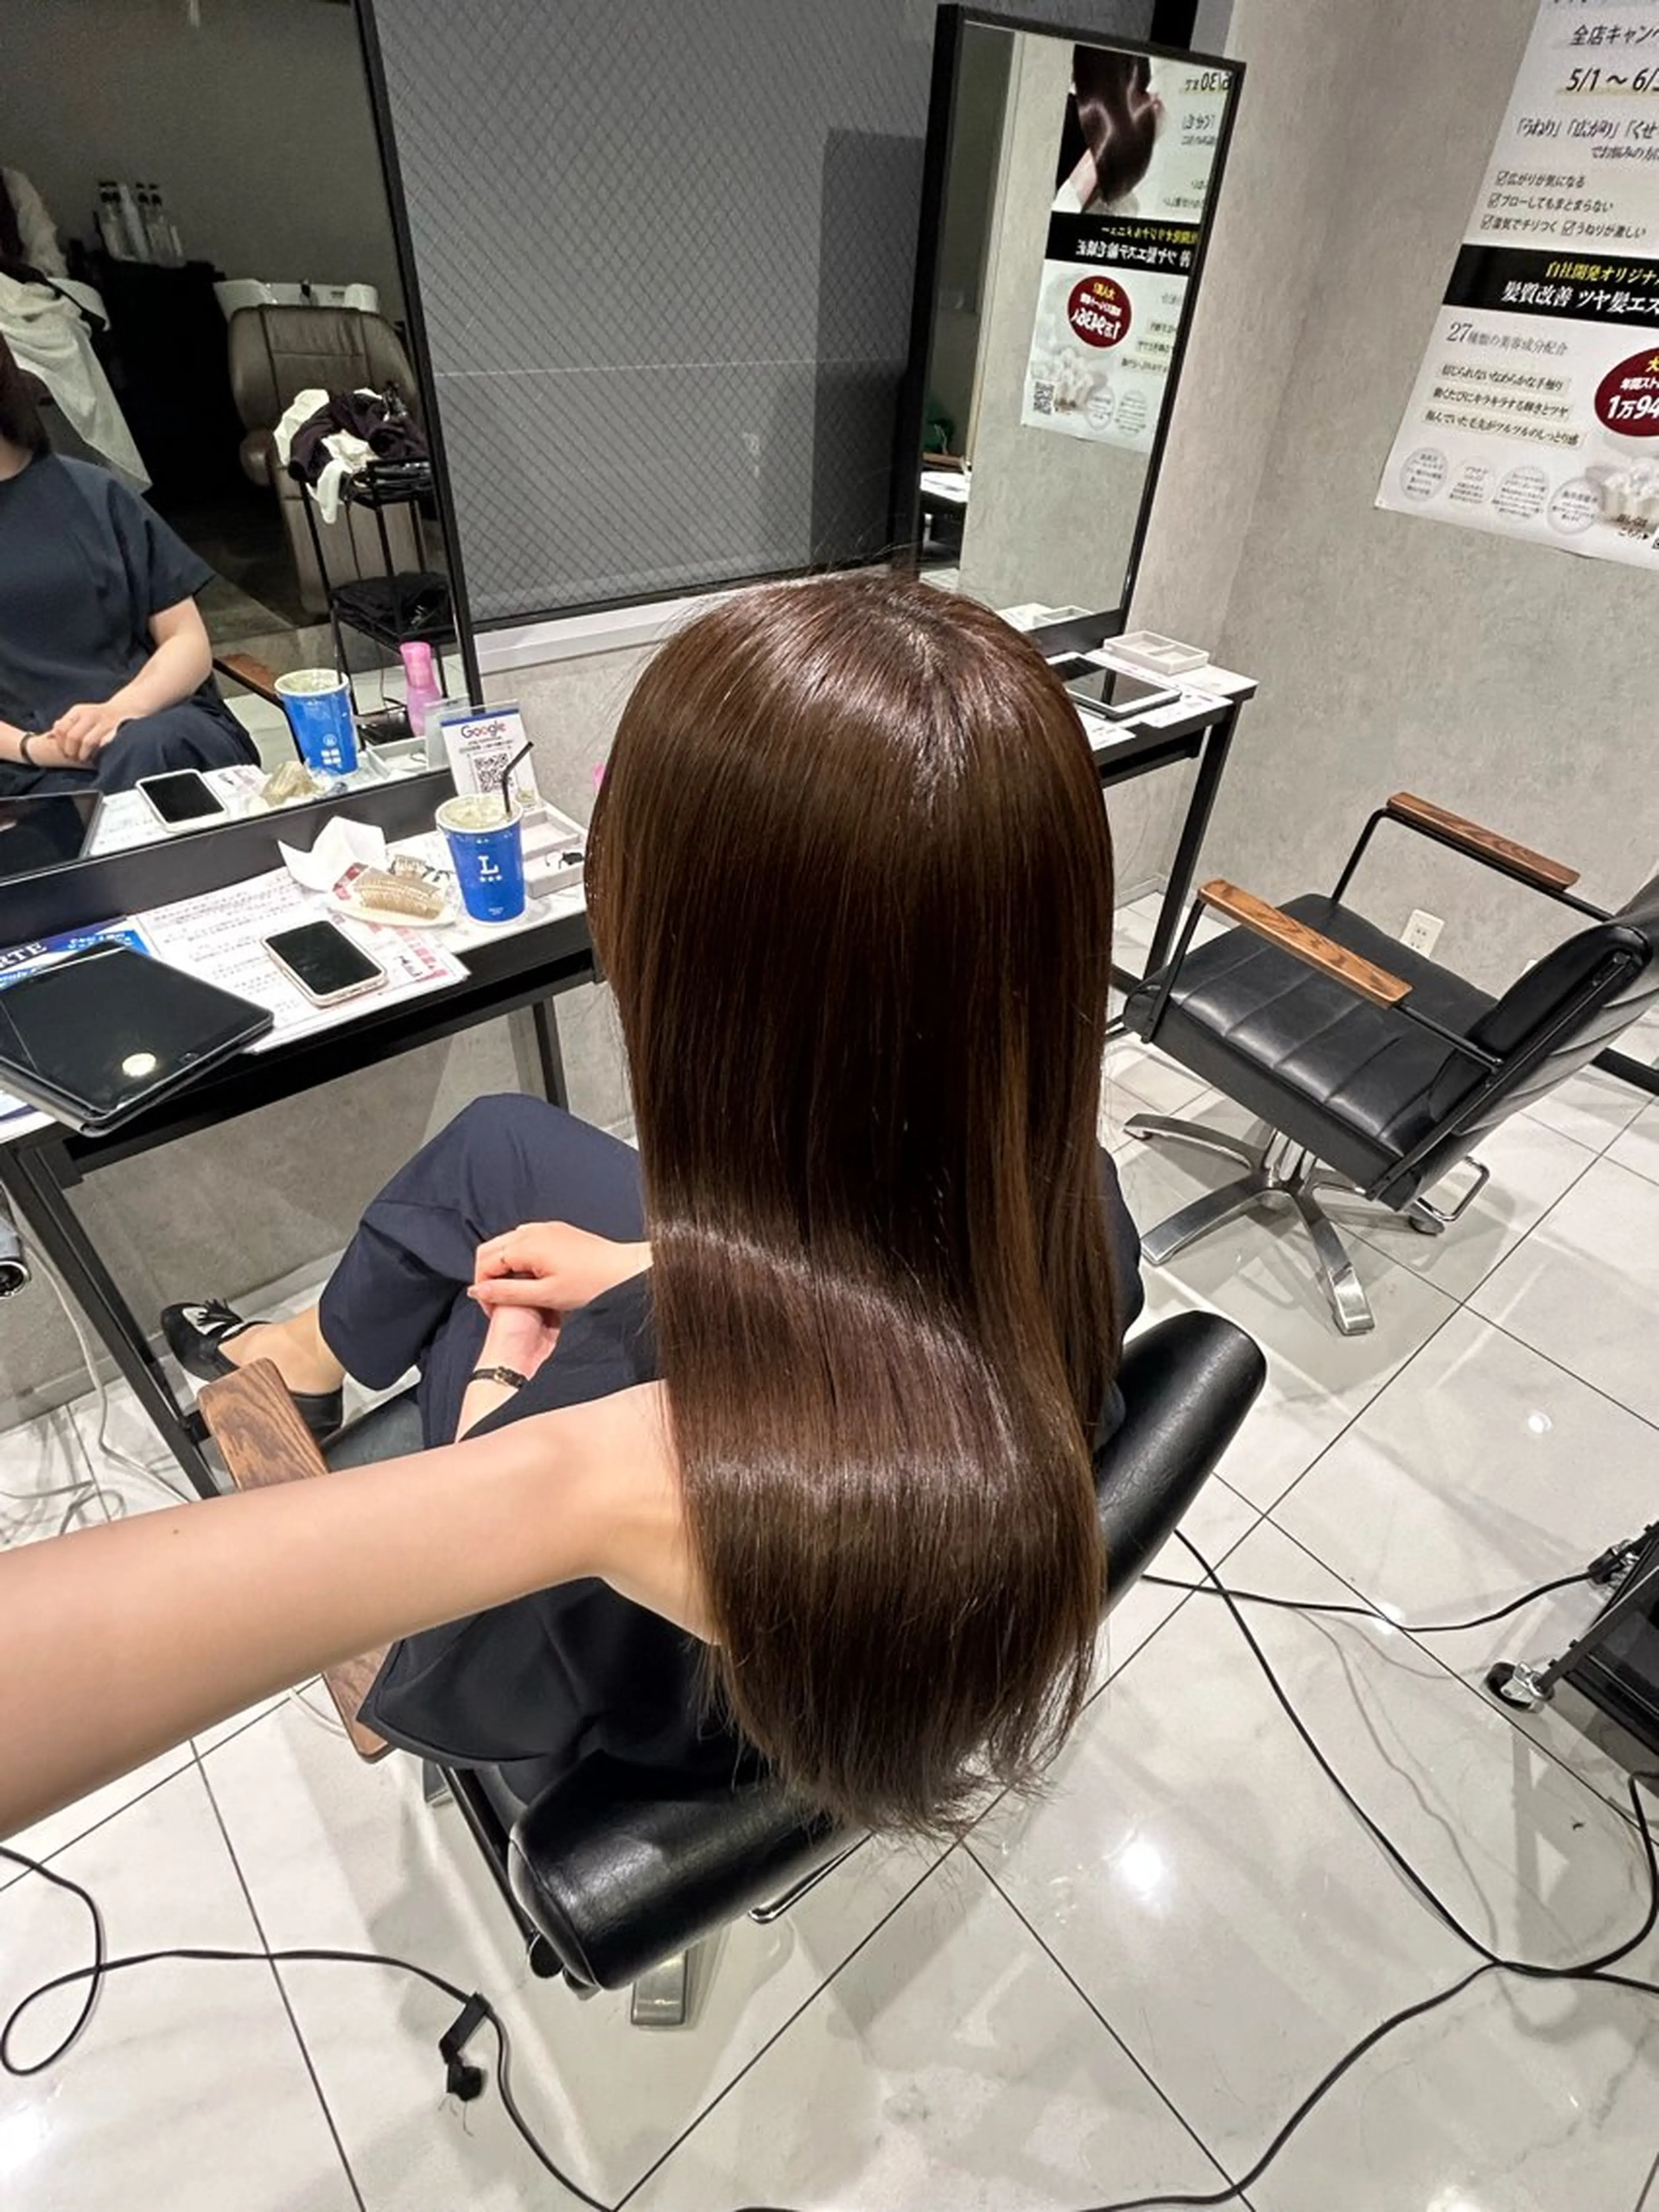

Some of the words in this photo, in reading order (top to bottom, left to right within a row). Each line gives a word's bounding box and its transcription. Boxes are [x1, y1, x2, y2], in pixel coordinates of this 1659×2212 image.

[1566, 67, 1601, 92] 5/1
[1501, 194, 1614, 213] ブローしてもまとまらない
[1501, 280, 1574, 307] 髪質改善
[461, 720, 506, 738] Google
